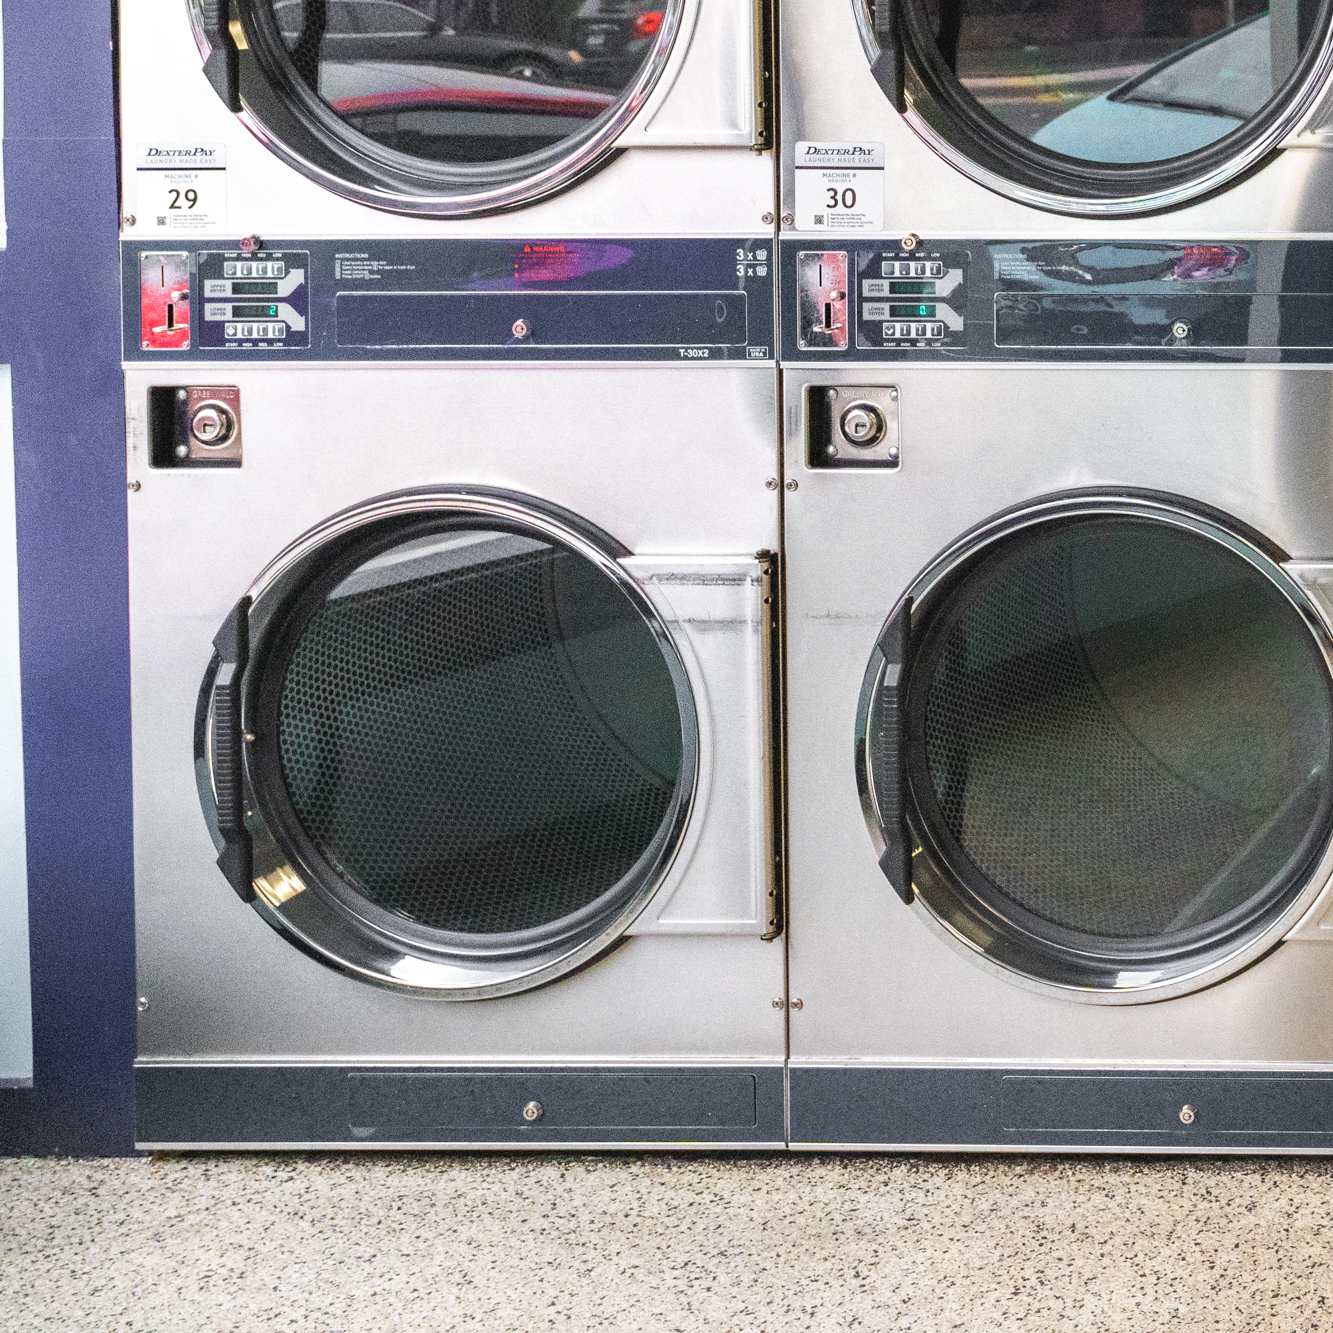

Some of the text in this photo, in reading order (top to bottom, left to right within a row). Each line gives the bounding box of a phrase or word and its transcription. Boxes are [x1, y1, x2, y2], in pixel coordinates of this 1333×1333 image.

[168, 187, 199, 211] 29
[825, 186, 857, 210] 30
[678, 348, 709, 357] T-30X2
